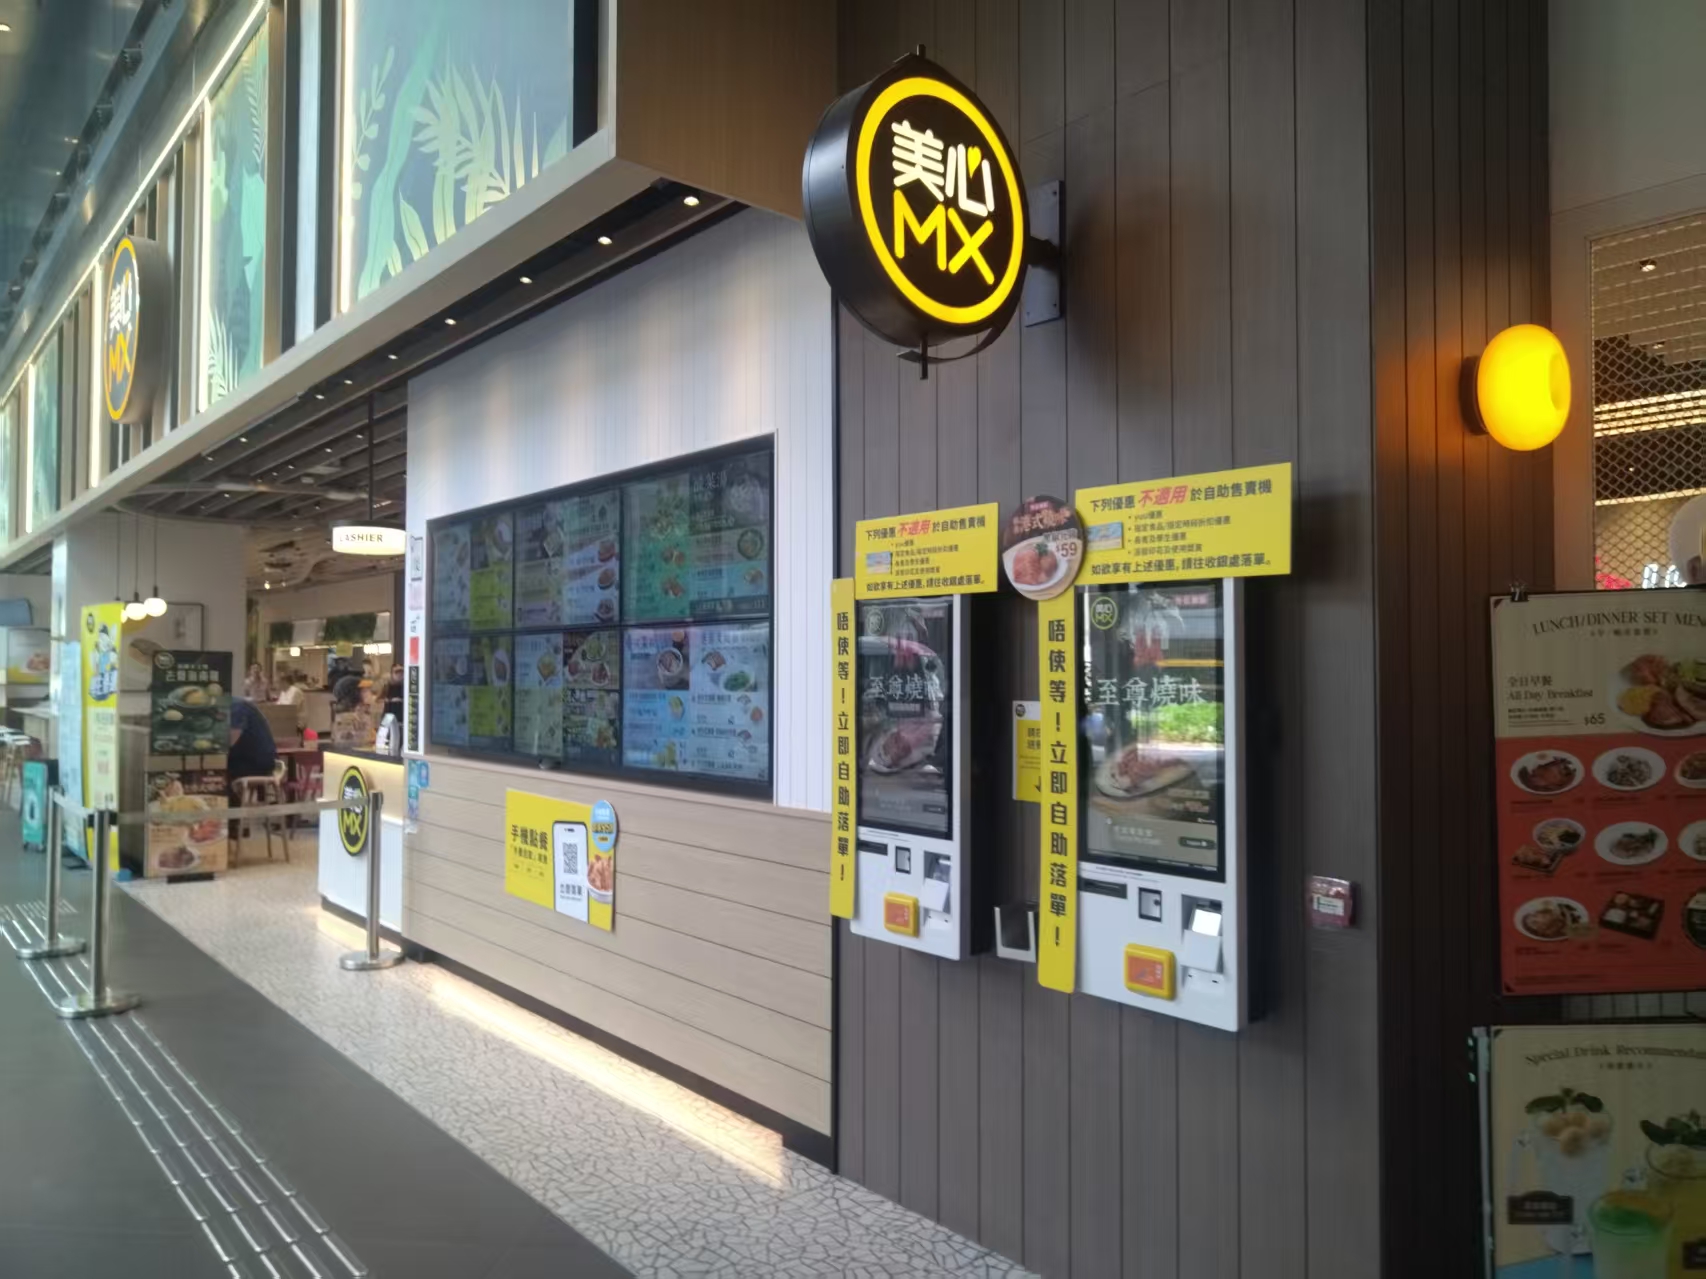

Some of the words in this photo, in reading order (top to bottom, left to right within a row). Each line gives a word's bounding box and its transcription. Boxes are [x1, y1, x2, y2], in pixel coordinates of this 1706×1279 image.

[891, 120, 995, 217] 美心
[893, 189, 995, 285] MX
[340, 533, 383, 543] ASHIER
[1532, 612, 1638, 635] LUNCH/DINNER
[1643, 611, 1669, 625] SET
[1674, 613, 1706, 627] MEN
[1095, 674, 1207, 708] 至尊燒味
[344, 810, 362, 836] MX
